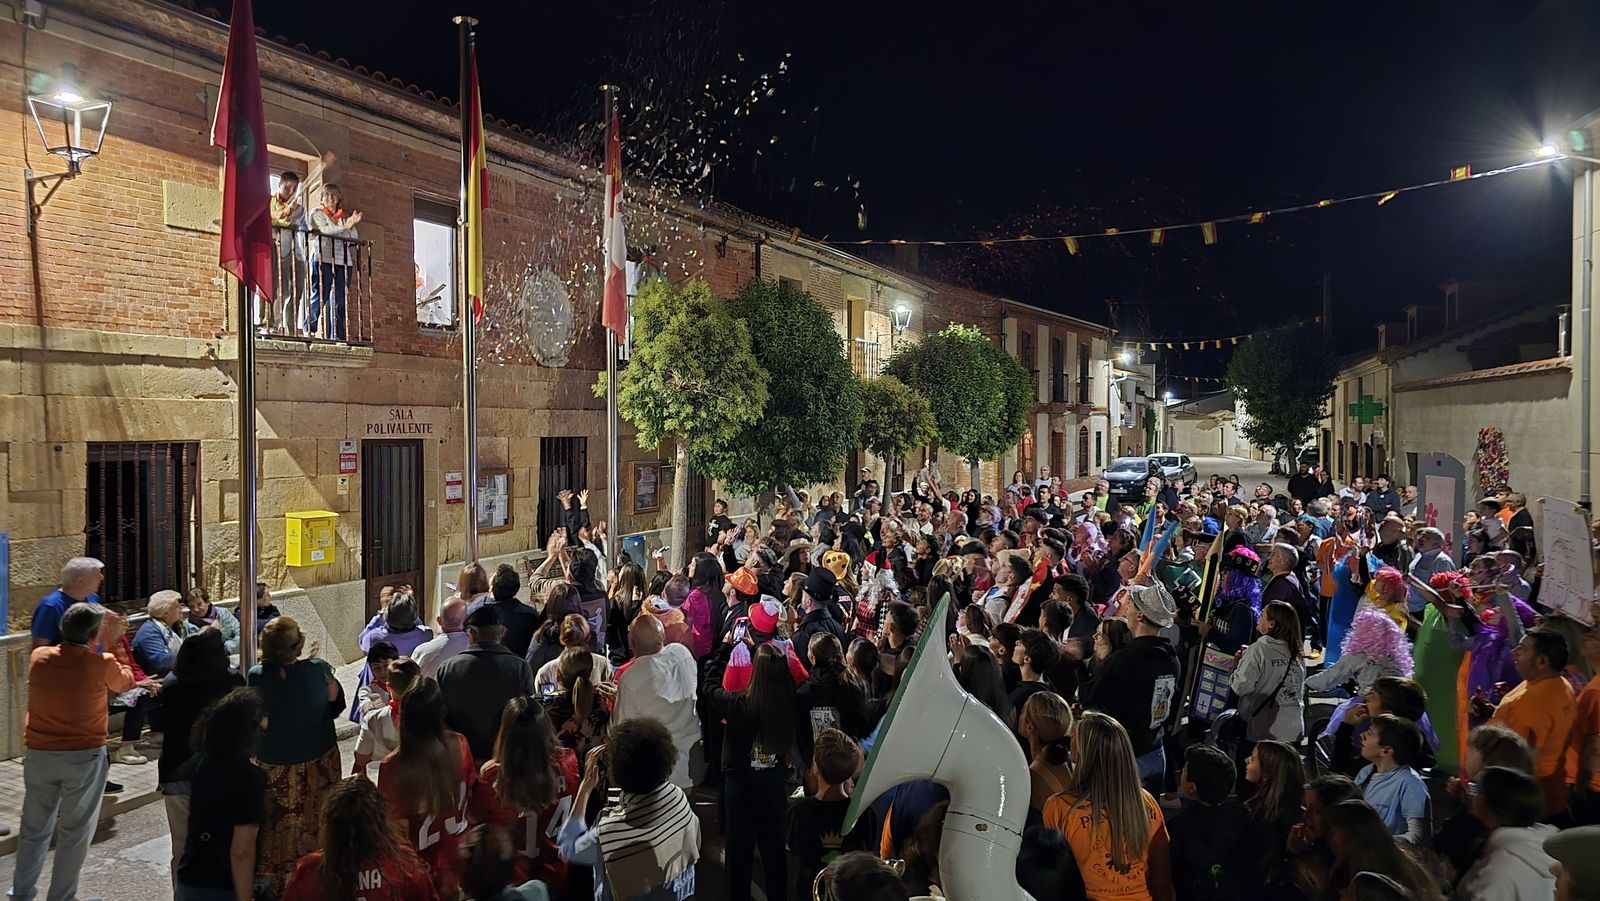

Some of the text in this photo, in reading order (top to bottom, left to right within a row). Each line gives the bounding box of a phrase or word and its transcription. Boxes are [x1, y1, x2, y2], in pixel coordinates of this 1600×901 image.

[389, 409, 414, 421] SALA
[366, 423, 433, 434] POLIVALENTE
[357, 868, 382, 890] NA
